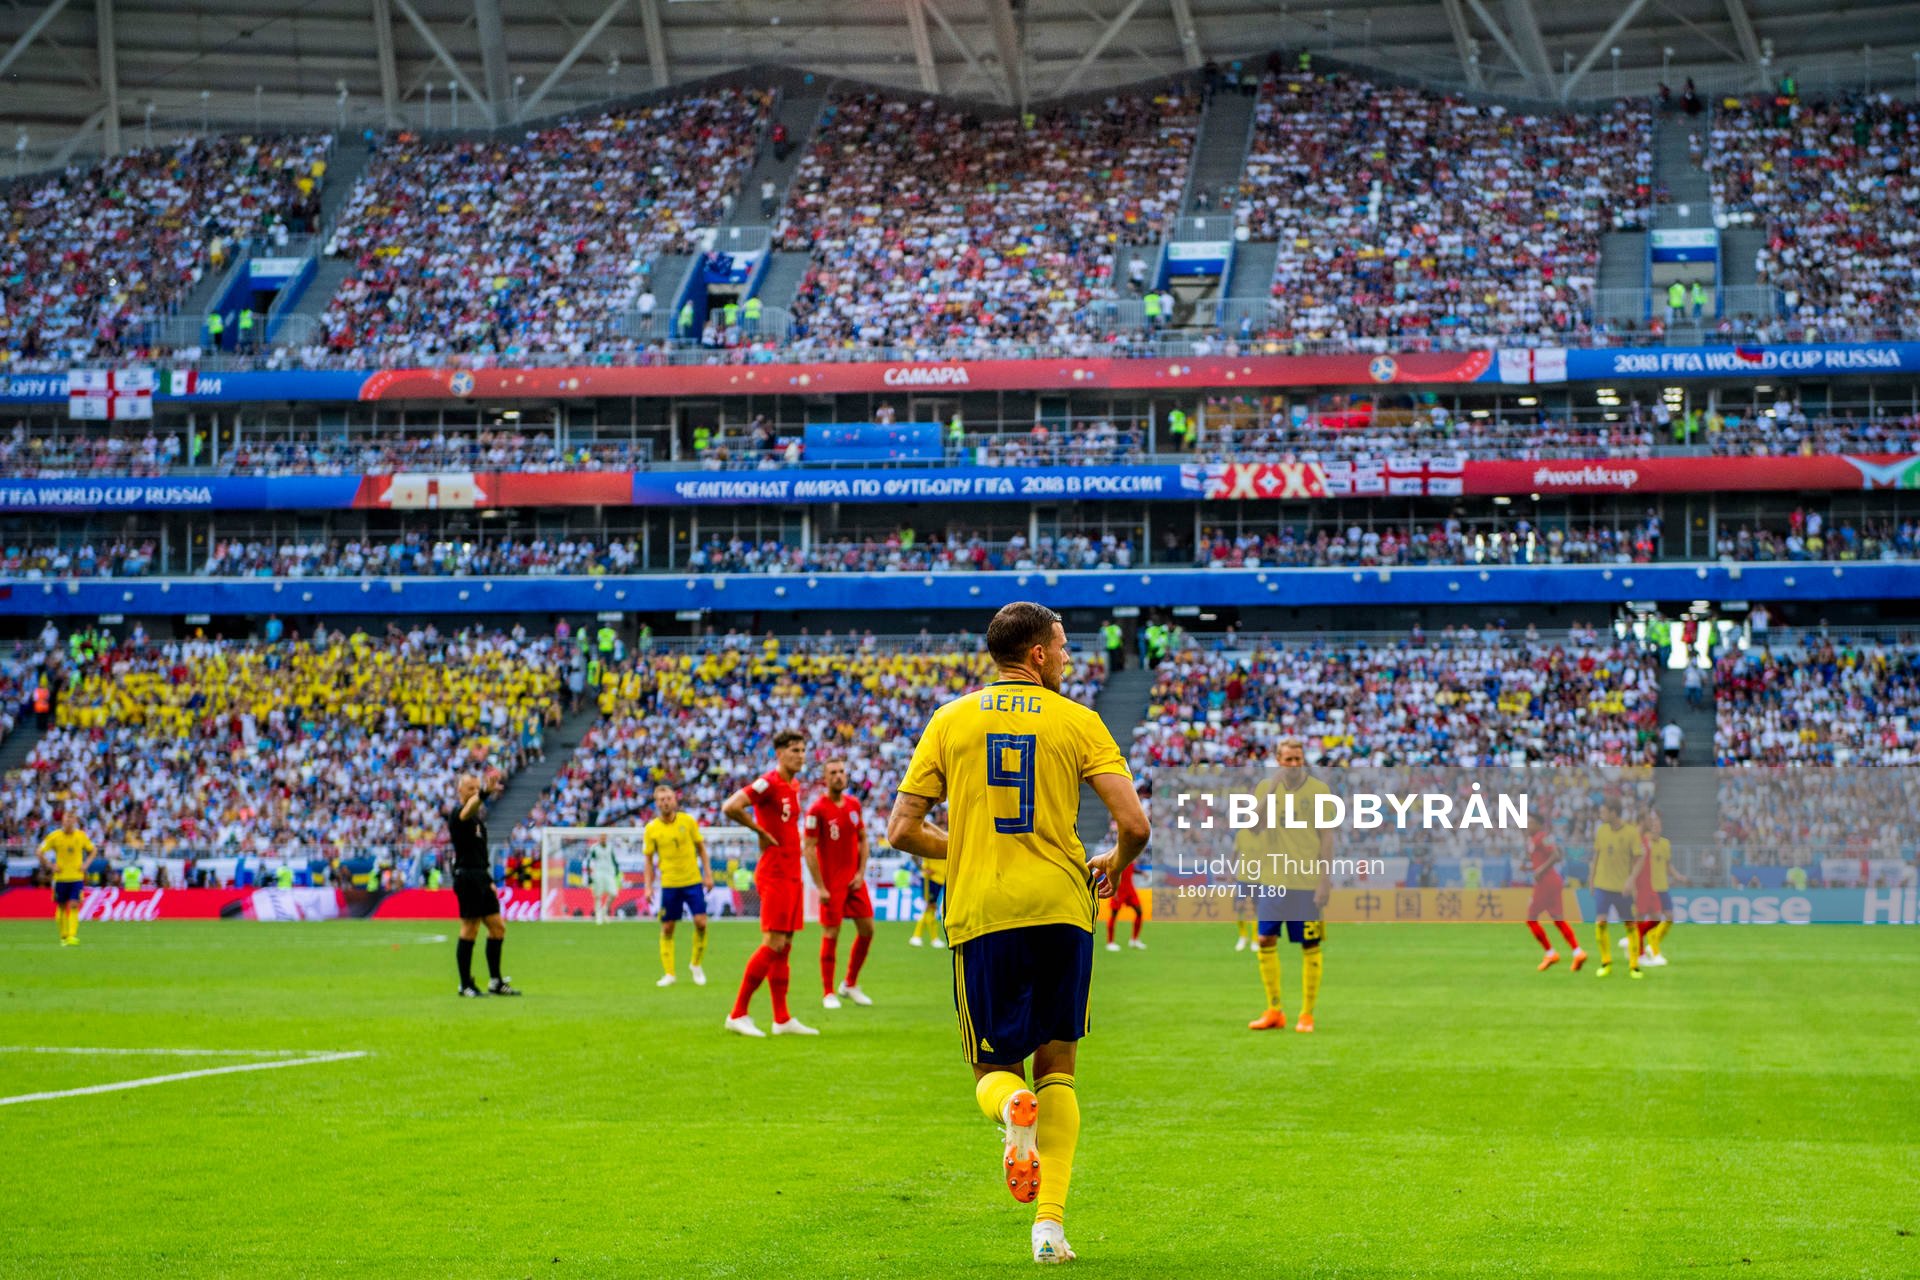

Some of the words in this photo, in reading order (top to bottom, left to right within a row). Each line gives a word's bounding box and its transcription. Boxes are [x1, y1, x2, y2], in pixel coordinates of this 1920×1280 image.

[1614, 354, 1660, 373] 2018
[1662, 353, 1704, 372] FIFA
[1779, 350, 1823, 369] CUP
[1825, 348, 1901, 368] RUSSIA
[675, 480, 790, 499] ЧЕМПИОНАТ
[794, 479, 849, 497] МИРА
[852, 479, 881, 495] ПО
[883, 477, 971, 496] ФУТБОЛУ
[974, 477, 1015, 495] FIFA
[1021, 476, 1064, 494] 2018
[1083, 475, 1162, 493] РОССИИ
[1533, 465, 1638, 489] #worldcup
[38, 487, 103, 505] WORLD
[105, 486, 143, 505] CUP
[145, 485, 213, 504] RUSSIA
[980, 694, 1041, 713] BERG
[986, 733, 1036, 834] 9
[781, 803, 791, 823] 5
[79, 887, 163, 921] Bud
